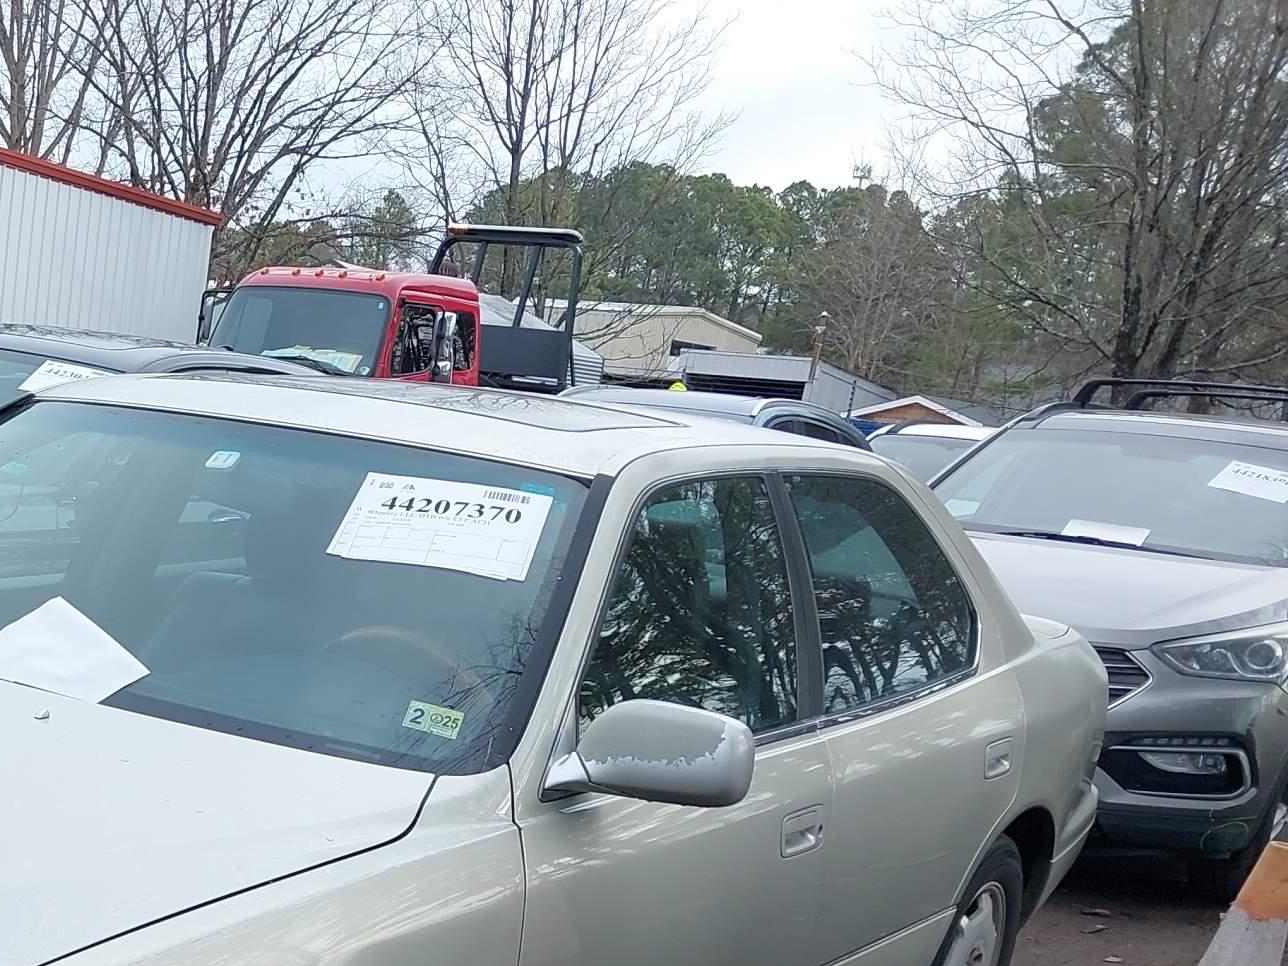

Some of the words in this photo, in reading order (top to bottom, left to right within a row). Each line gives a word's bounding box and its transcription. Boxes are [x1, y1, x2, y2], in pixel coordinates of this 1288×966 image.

[381, 496, 522, 524] 44207370
[409, 708, 425, 724] 2
[442, 715, 461, 729] 25
